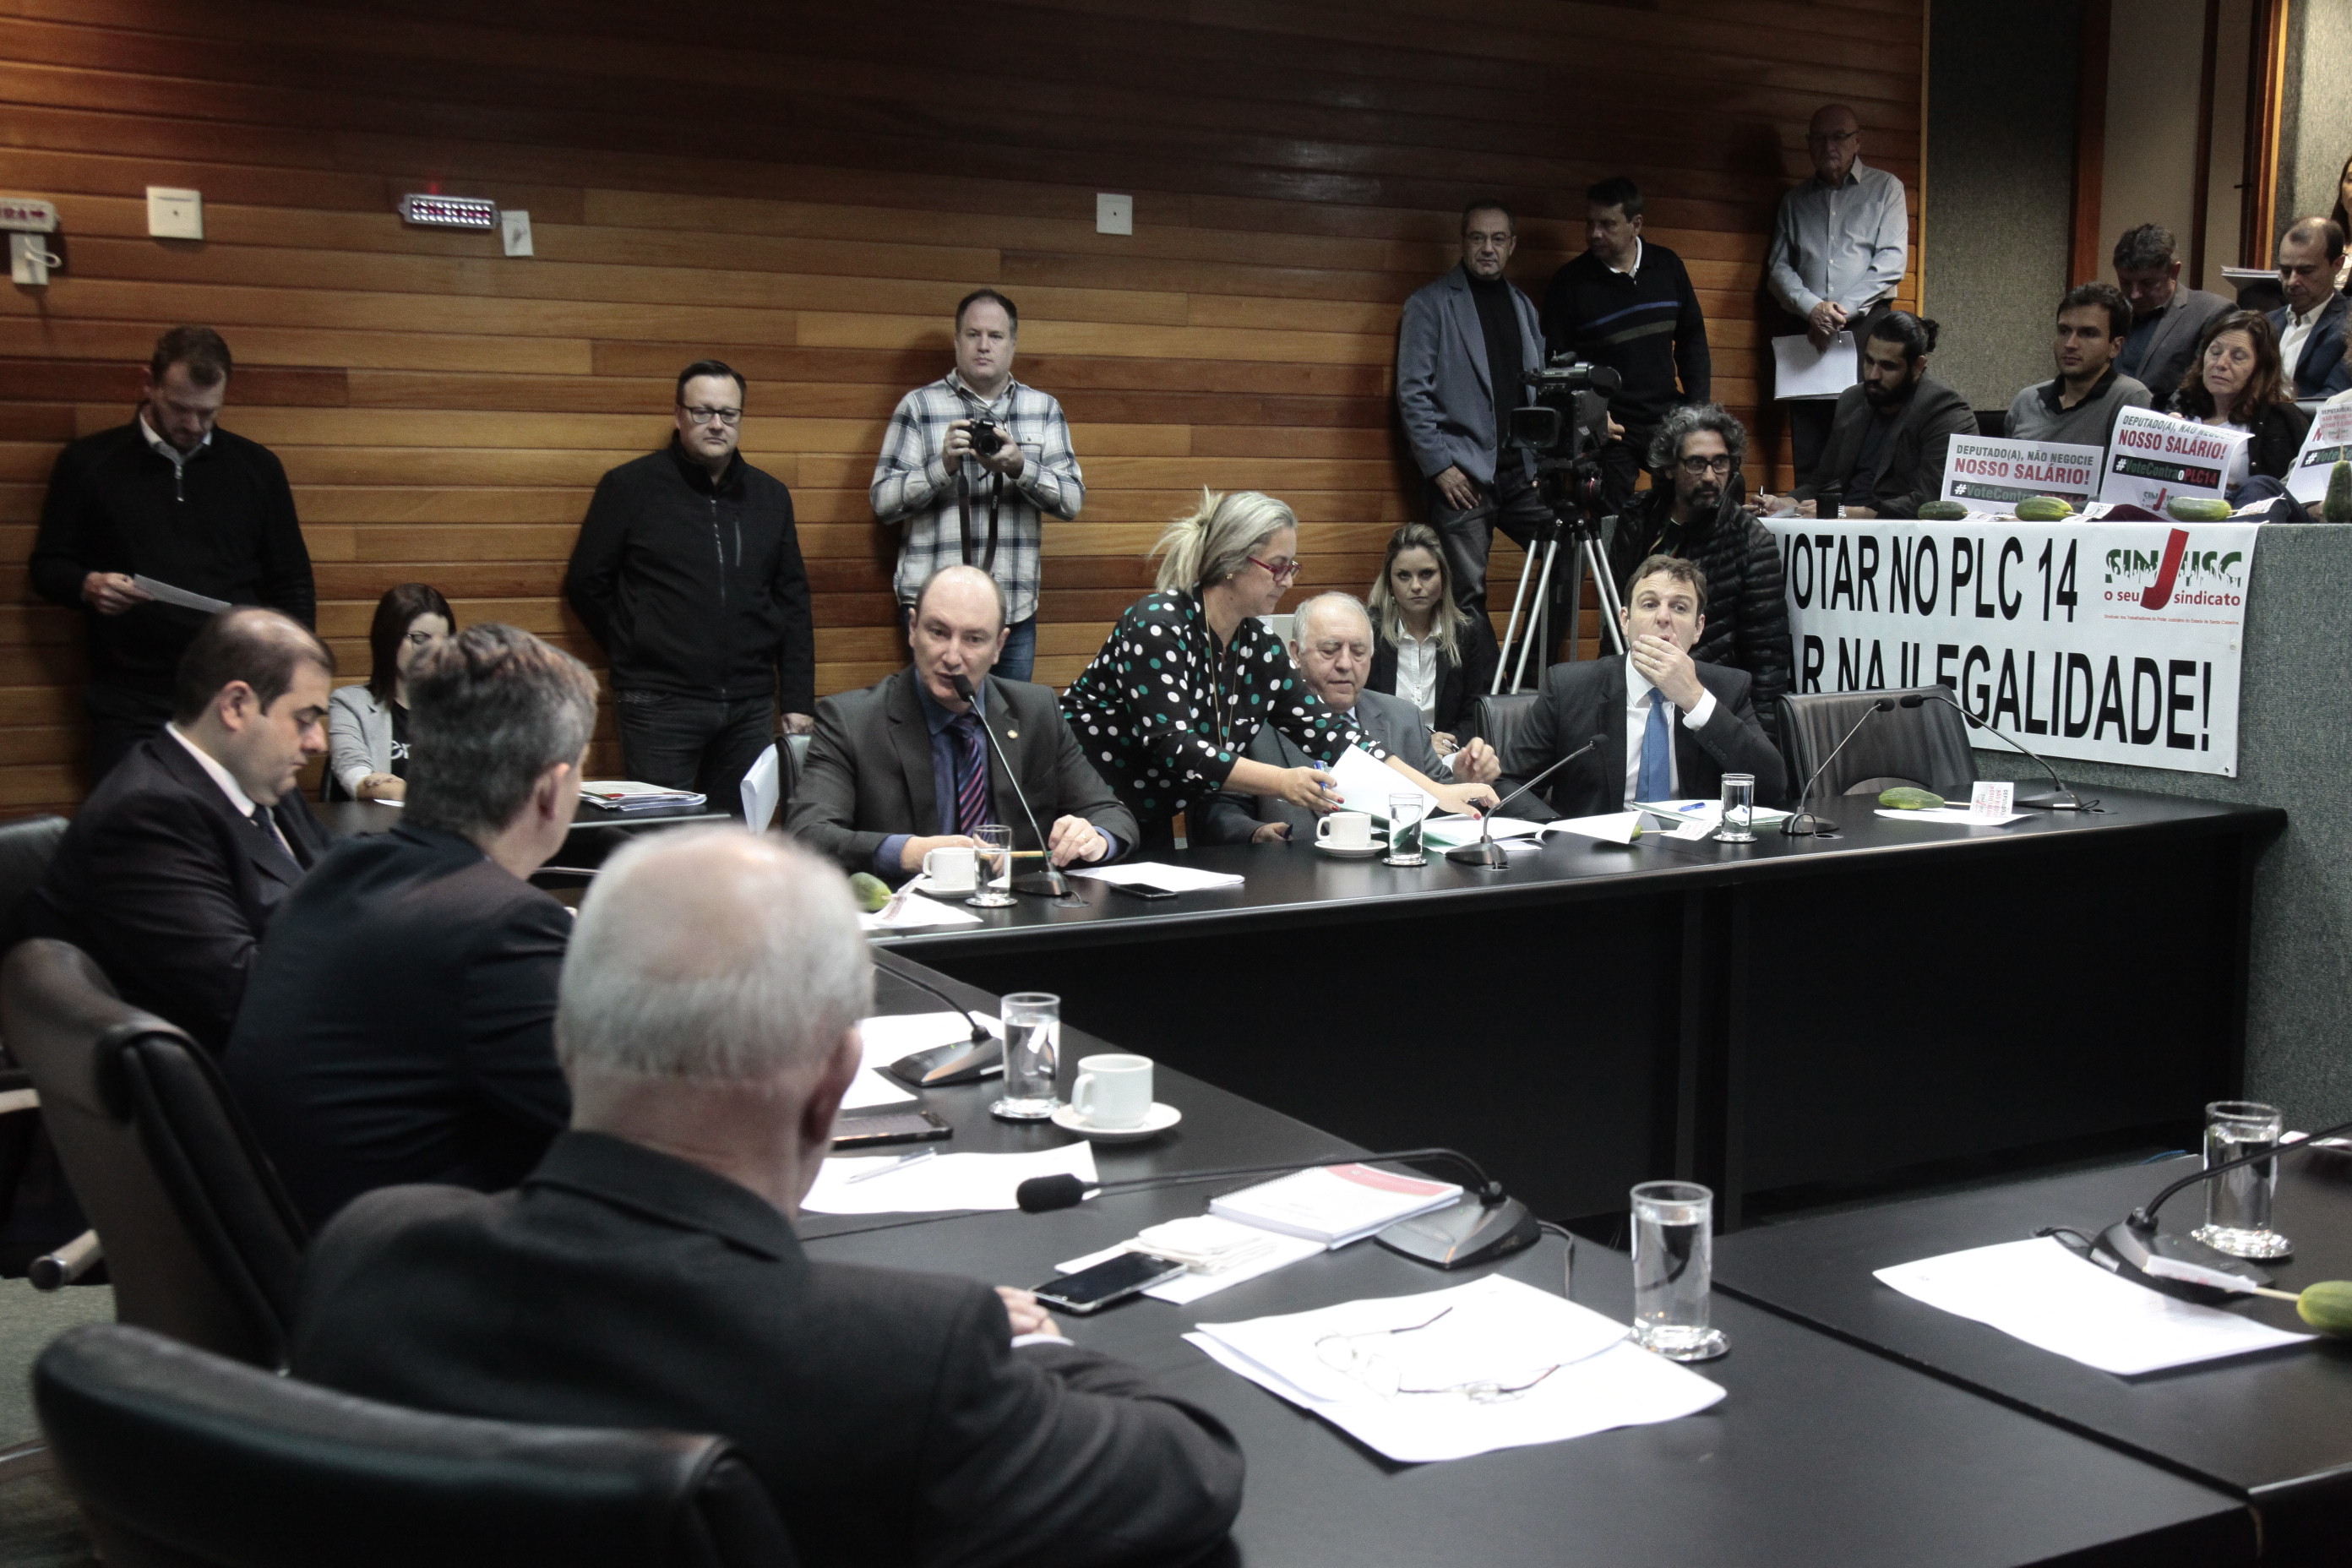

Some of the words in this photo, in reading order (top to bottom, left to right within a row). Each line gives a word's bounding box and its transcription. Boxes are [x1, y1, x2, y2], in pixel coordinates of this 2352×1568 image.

[2123, 415, 2176, 433] DEPUTADO(A),
[1957, 444, 2023, 461] DEPUTADO(A),
[2027, 449, 2047, 462] NÃO
[2050, 453, 2093, 466] NEGOCIE
[2118, 429, 2162, 450] NOSSO
[2165, 435, 2229, 460] SALÁRIO!
[1955, 458, 2009, 477] NOSSO
[2014, 462, 2091, 485] SALÁRIO!
[2115, 458, 2218, 486] #VoteContraoPLC14
[1889, 535, 1939, 617] NO
[1951, 536, 2023, 621] PLC
[2039, 538, 2077, 623] 14
[2104, 591, 2113, 601] o
[2117, 591, 2140, 602] seu
[2174, 590, 2240, 606] sindicato
